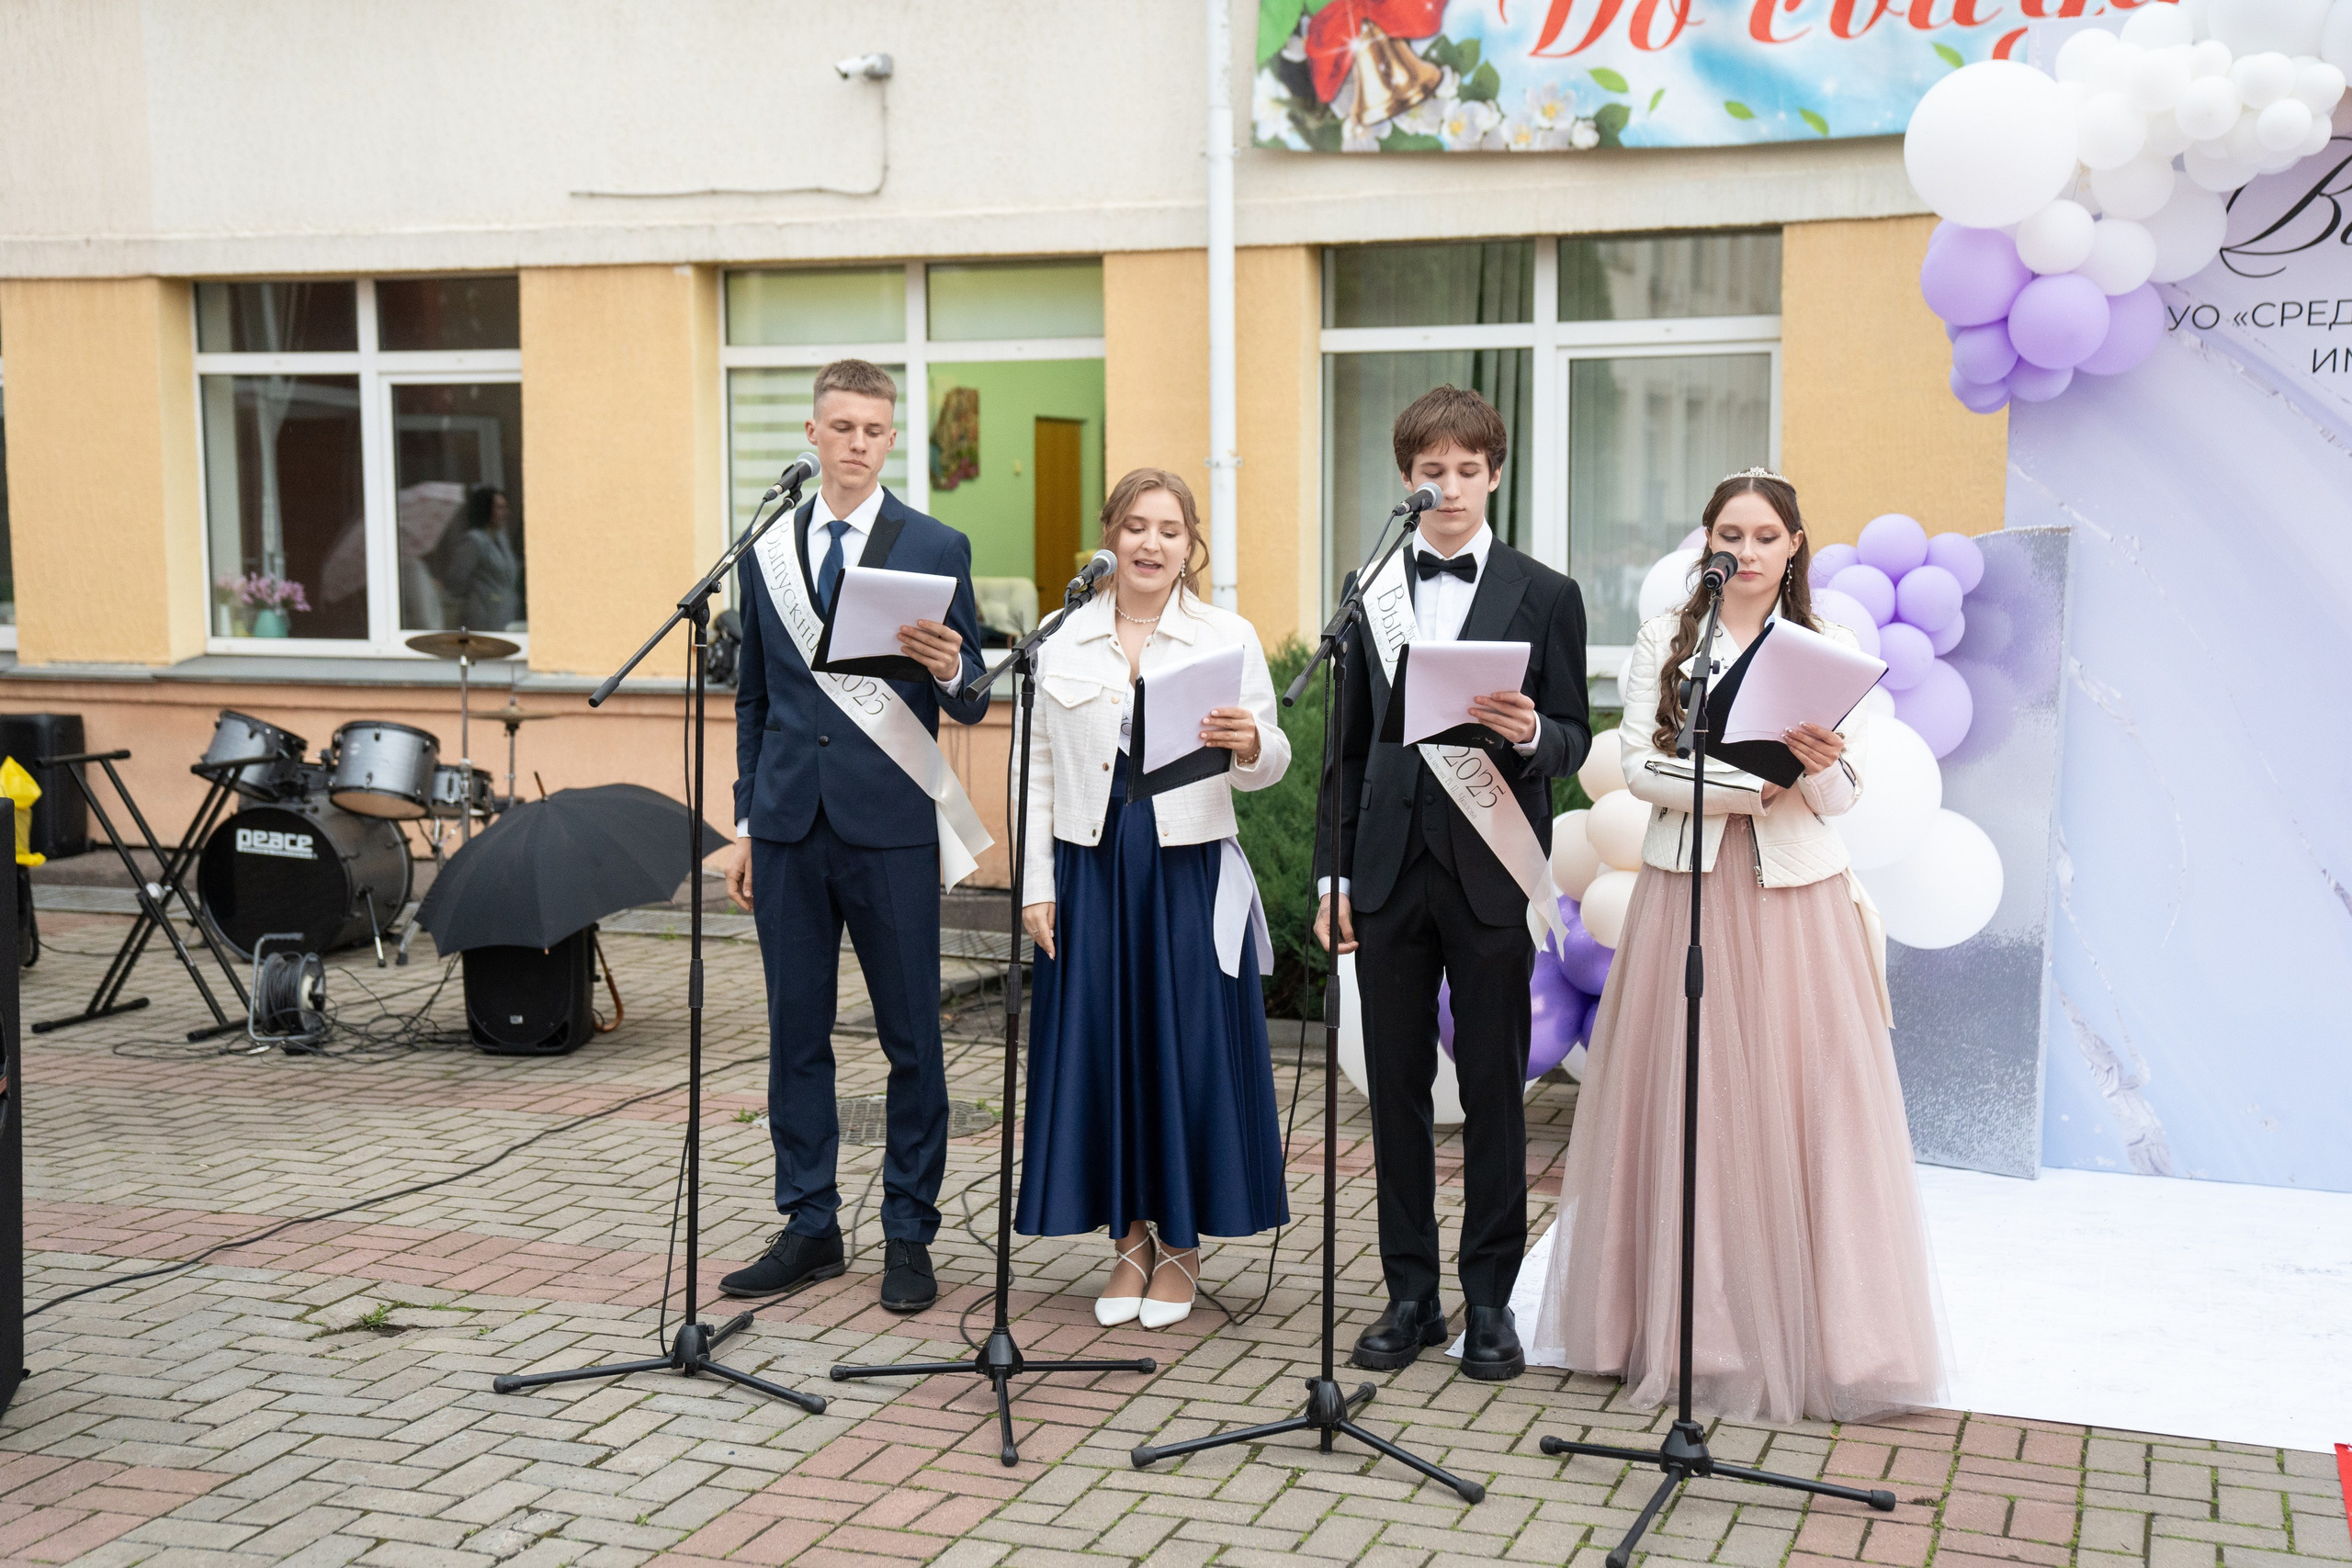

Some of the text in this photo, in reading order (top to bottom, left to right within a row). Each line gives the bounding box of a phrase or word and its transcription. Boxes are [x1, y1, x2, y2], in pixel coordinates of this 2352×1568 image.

[2312, 347, 2352, 373] И
[828, 672, 893, 715] 025
[1442, 747, 1507, 808] 2025
[236, 829, 313, 854] peace
